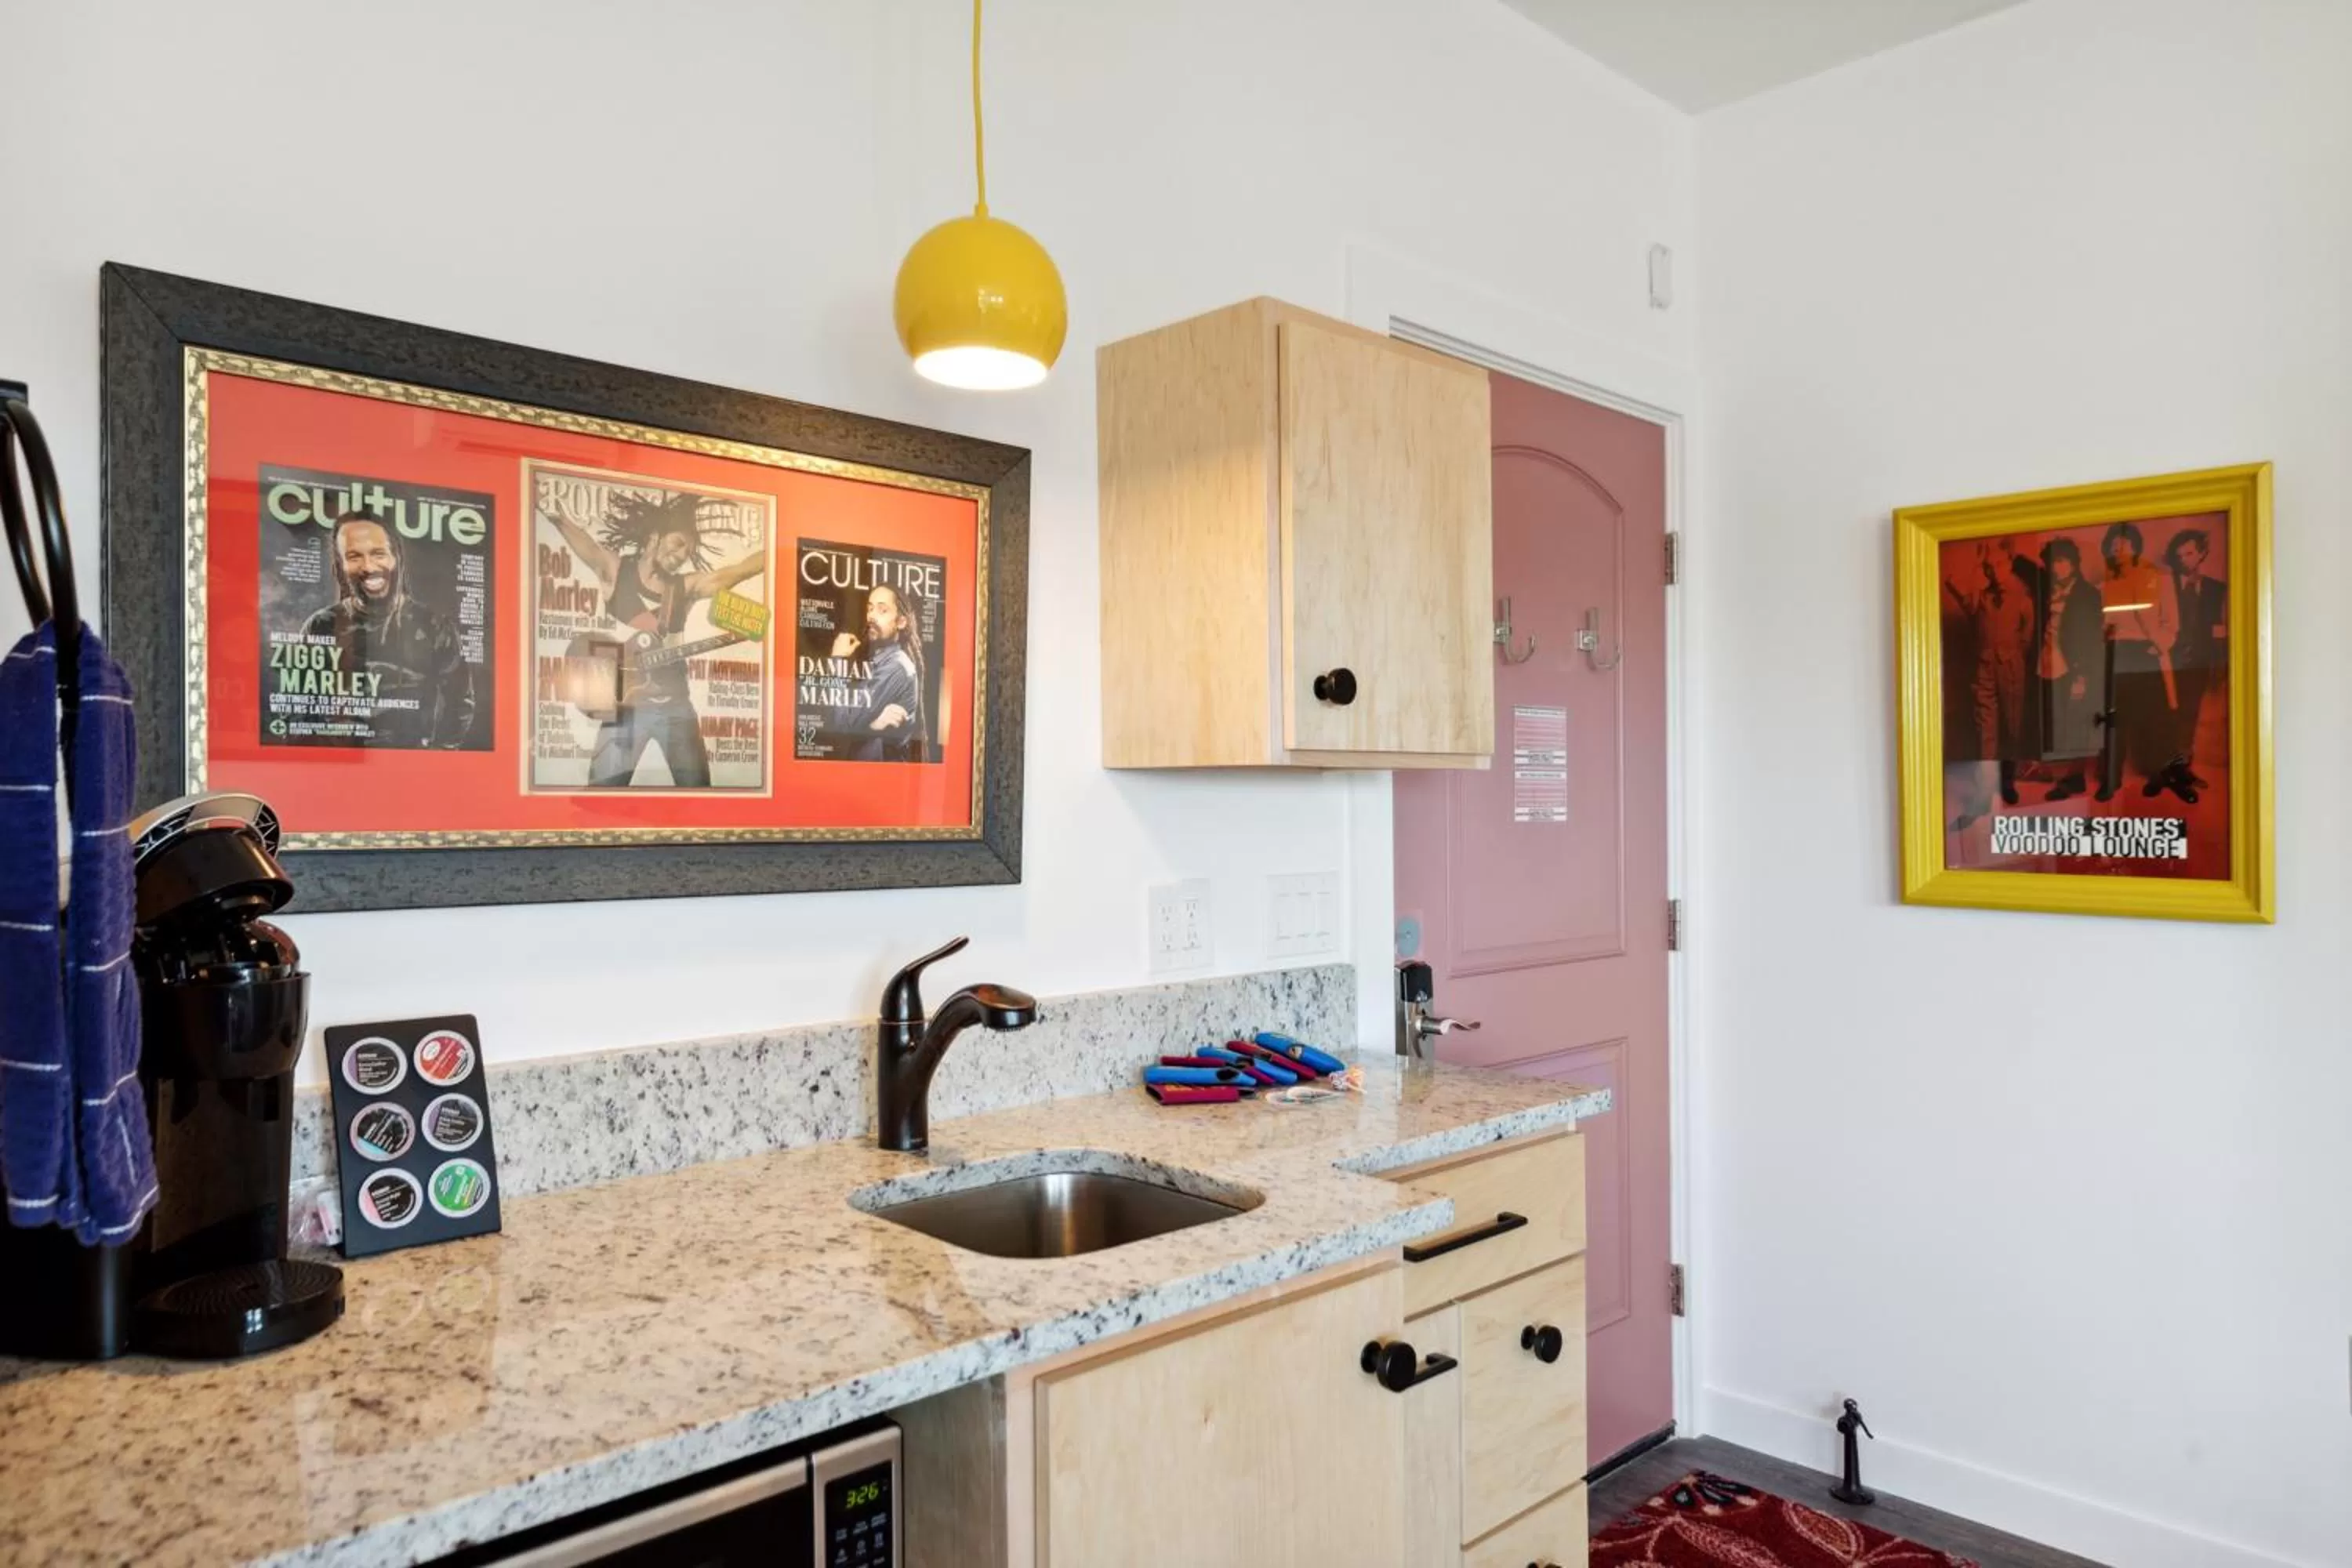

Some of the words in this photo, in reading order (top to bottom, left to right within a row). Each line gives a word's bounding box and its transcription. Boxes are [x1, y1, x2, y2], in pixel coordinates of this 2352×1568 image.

[267, 482, 486, 545] culture
[539, 543, 571, 579] Bob
[800, 551, 940, 599] CULTURE
[539, 577, 598, 616] Marley
[270, 631, 305, 644] MELODY
[307, 634, 336, 645] MAKER
[270, 642, 343, 671] ZIGGY
[799, 655, 874, 680] DAMIAN
[280, 668, 383, 697] MARLEY
[270, 693, 315, 706] CONTINUES
[319, 695, 328, 705] TO
[330, 695, 376, 708] CAPTIVATE
[375, 699, 420, 710] AUDIENCES
[798, 686, 875, 708] MARLEY
[270, 703, 292, 713] WITH
[293, 704, 308, 714] HIS
[310, 705, 341, 715] LATEST
[343, 706, 372, 717] ALBUM
[799, 726, 816, 746] 32
[1994, 815, 2085, 837] ROLLING
[2091, 817, 2180, 840] STONES
[1995, 834, 2081, 855] VOODOO
[2089, 837, 2182, 858] LOUNGE
